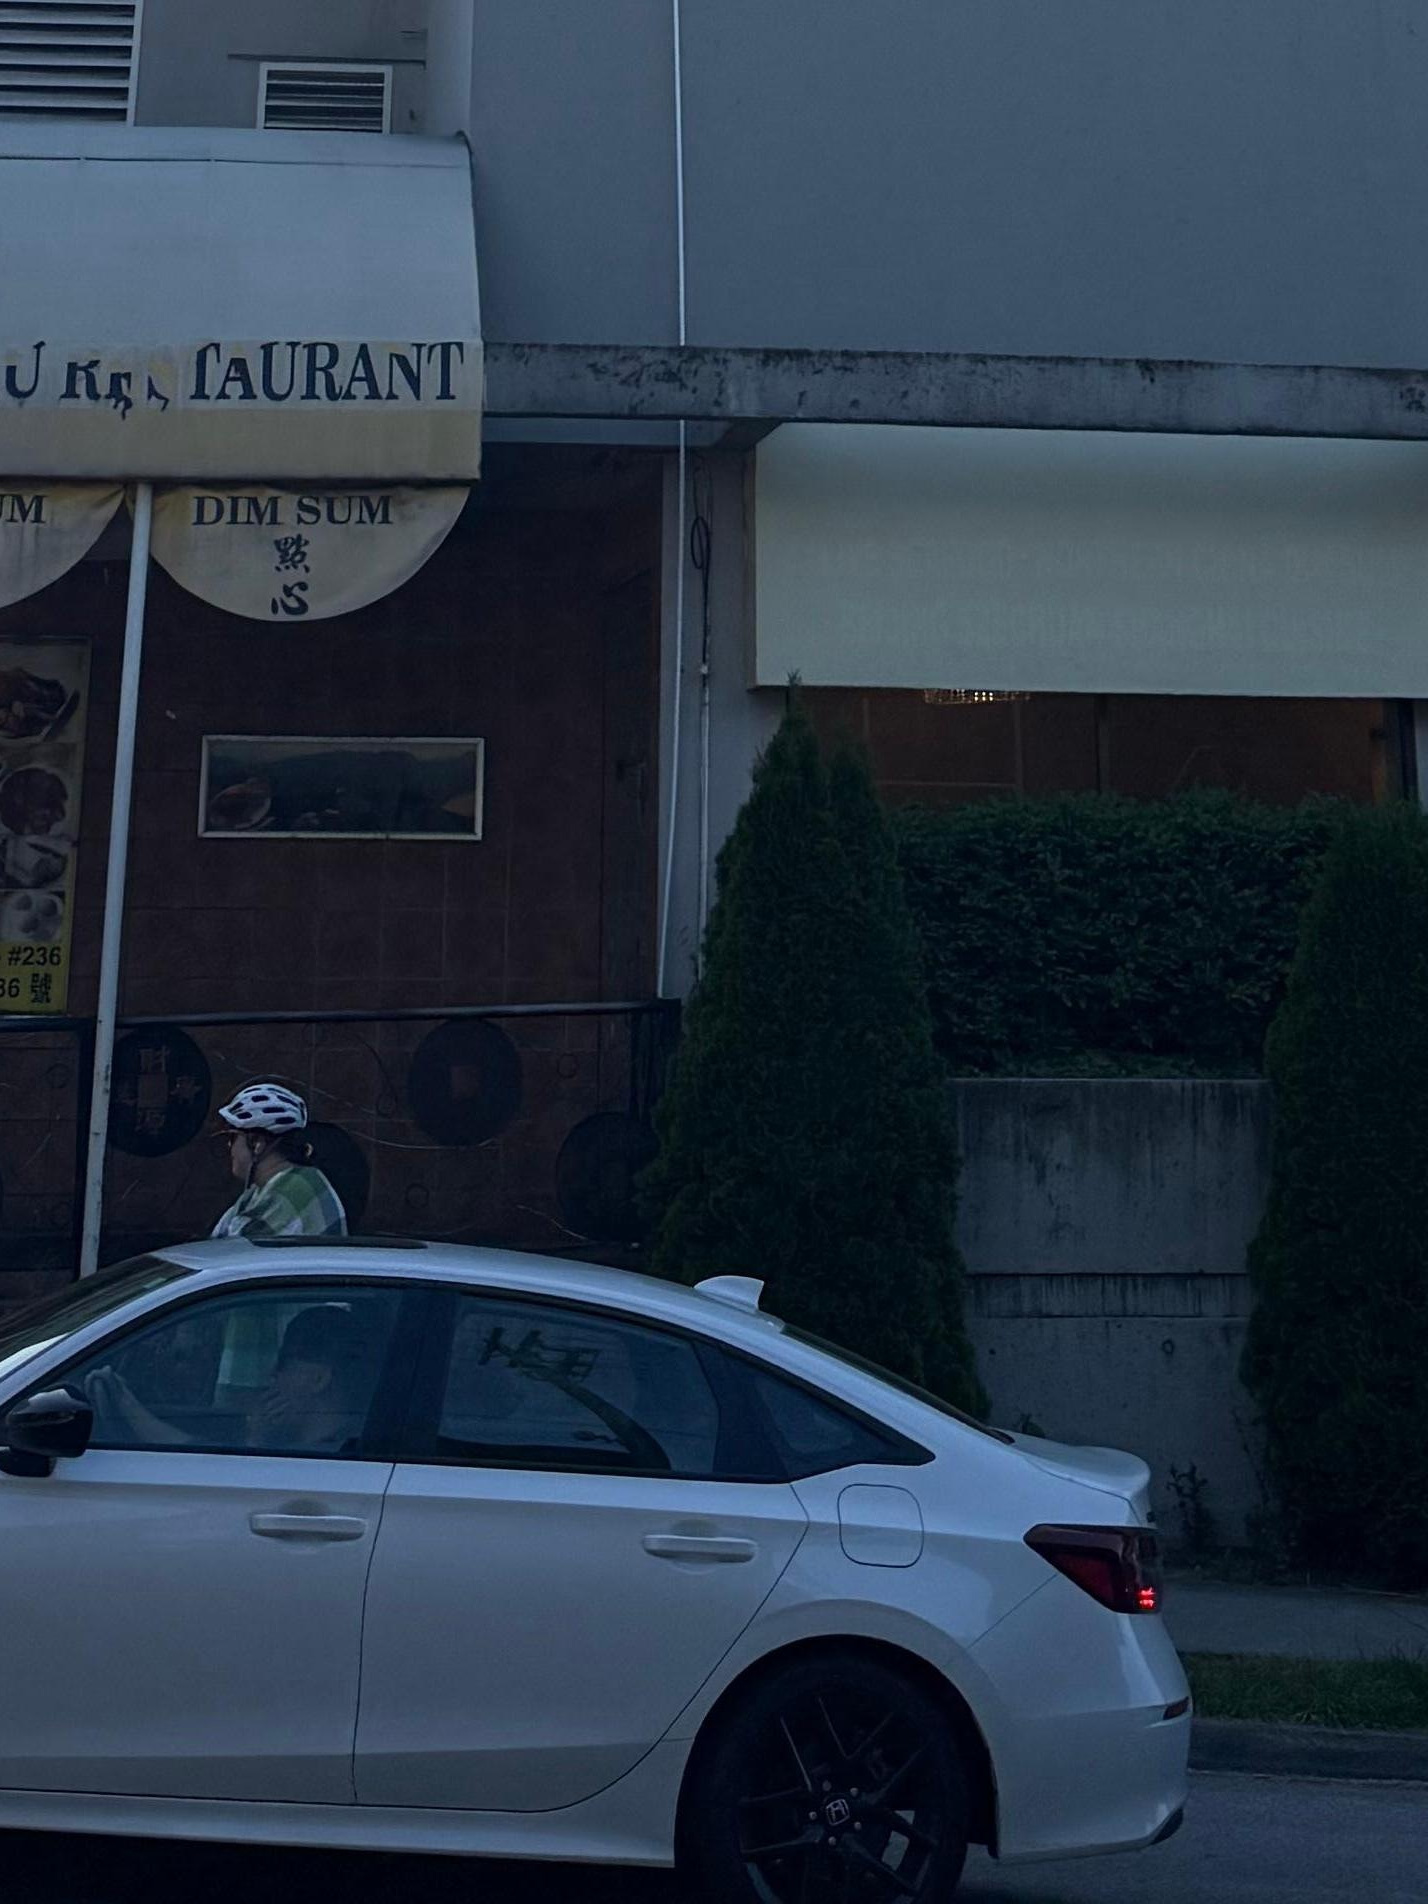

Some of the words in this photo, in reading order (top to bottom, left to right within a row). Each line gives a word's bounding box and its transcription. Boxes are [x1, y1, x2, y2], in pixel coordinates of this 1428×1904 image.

[192, 495, 280, 526] DIM
[296, 495, 393, 525] SUM
[8, 946, 62, 966] #236
